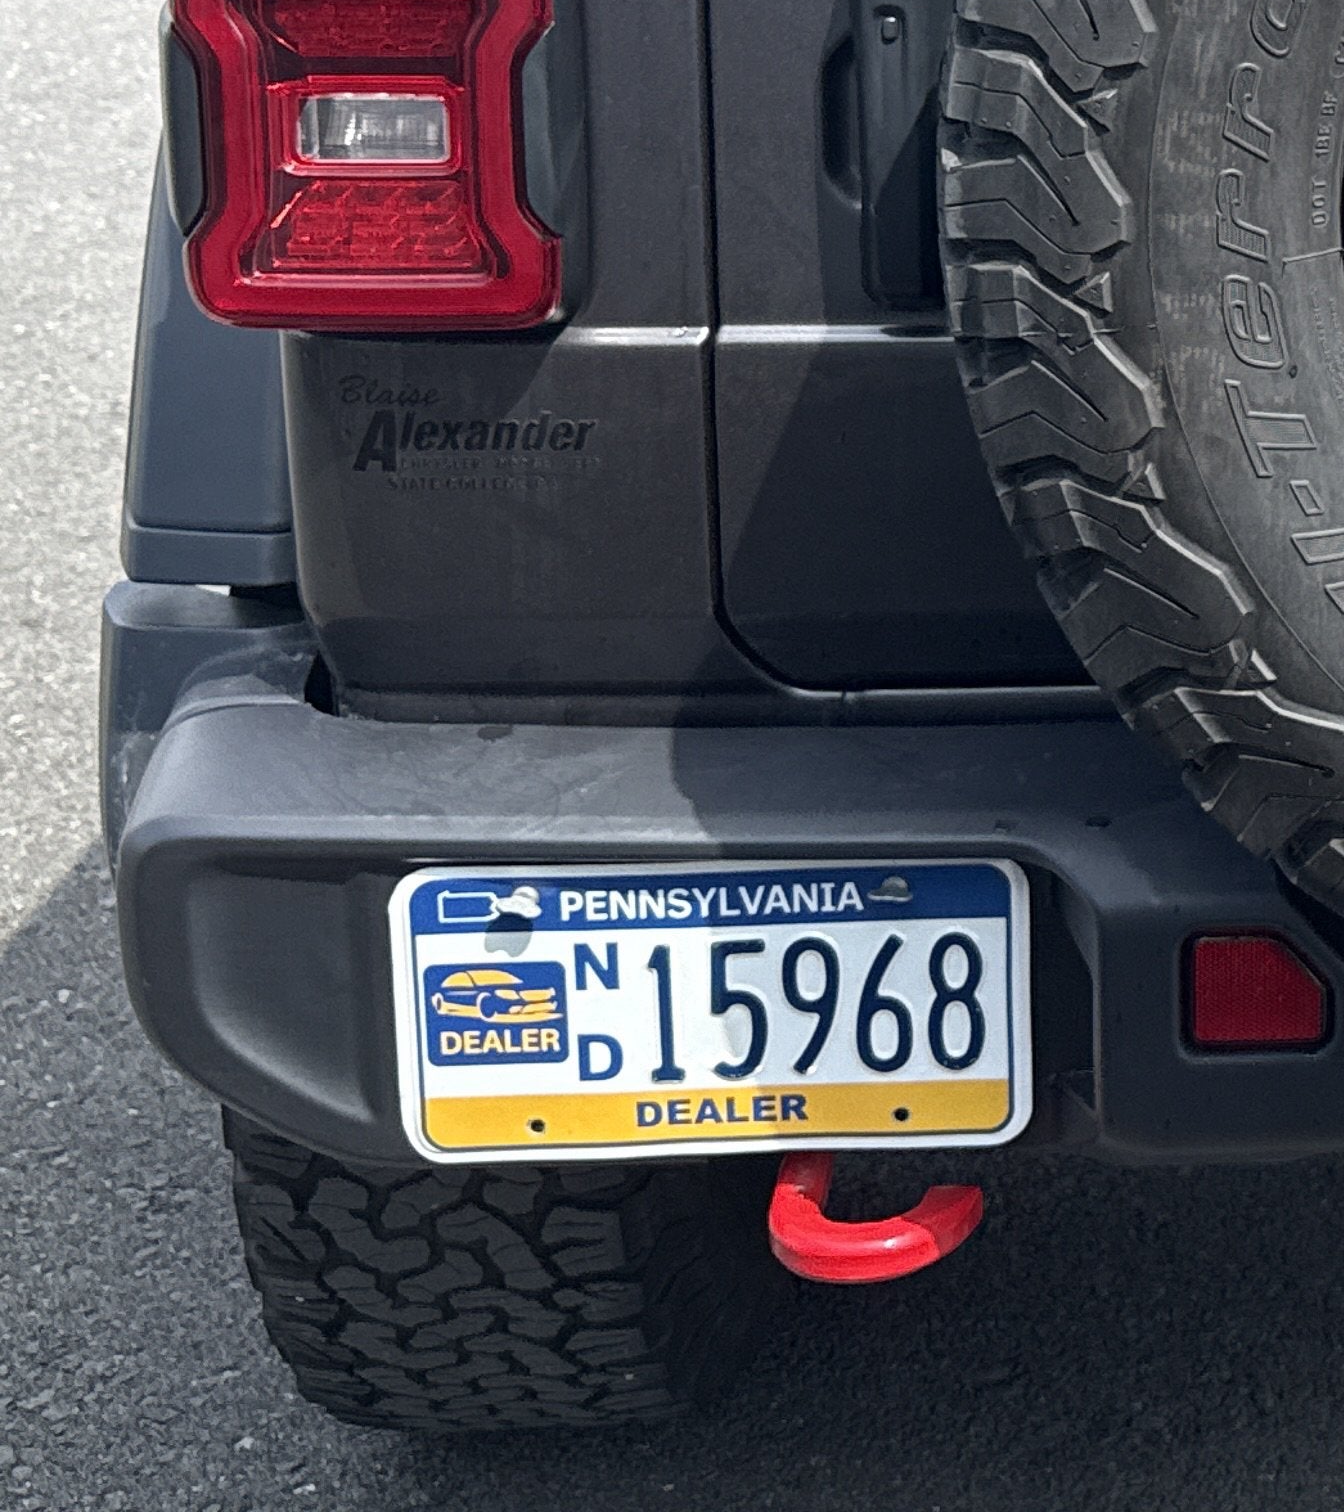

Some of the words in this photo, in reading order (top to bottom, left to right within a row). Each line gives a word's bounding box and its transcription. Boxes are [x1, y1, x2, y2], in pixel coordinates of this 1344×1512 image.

[352, 408, 596, 472] Alexander
[560, 881, 863, 921] PENNSYLVANIA
[574, 943, 618, 990] N
[645, 932, 986, 1083] 15968
[440, 1028, 560, 1056] DEALER
[578, 1034, 624, 1081] D
[636, 1094, 808, 1128] DEALER
